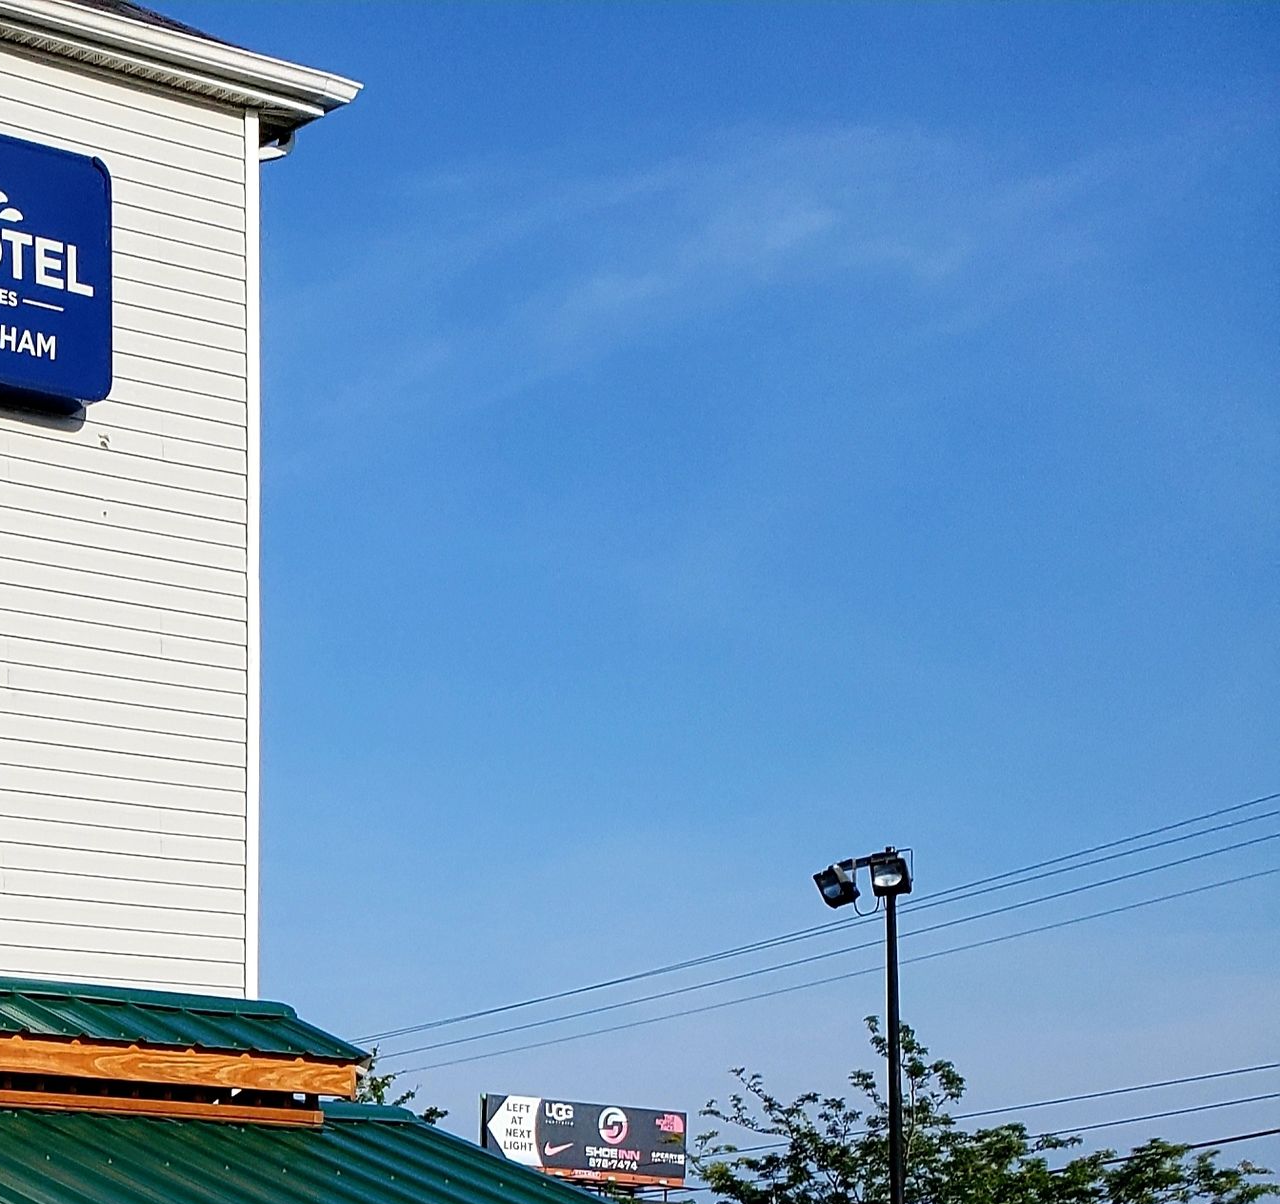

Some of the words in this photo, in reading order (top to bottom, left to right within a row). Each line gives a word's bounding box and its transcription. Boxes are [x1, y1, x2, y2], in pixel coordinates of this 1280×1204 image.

[506, 1102, 531, 1113] LEFT
[511, 1116, 523, 1125] AT
[505, 1128, 532, 1139] NEXT
[503, 1141, 534, 1152] LIGHT
